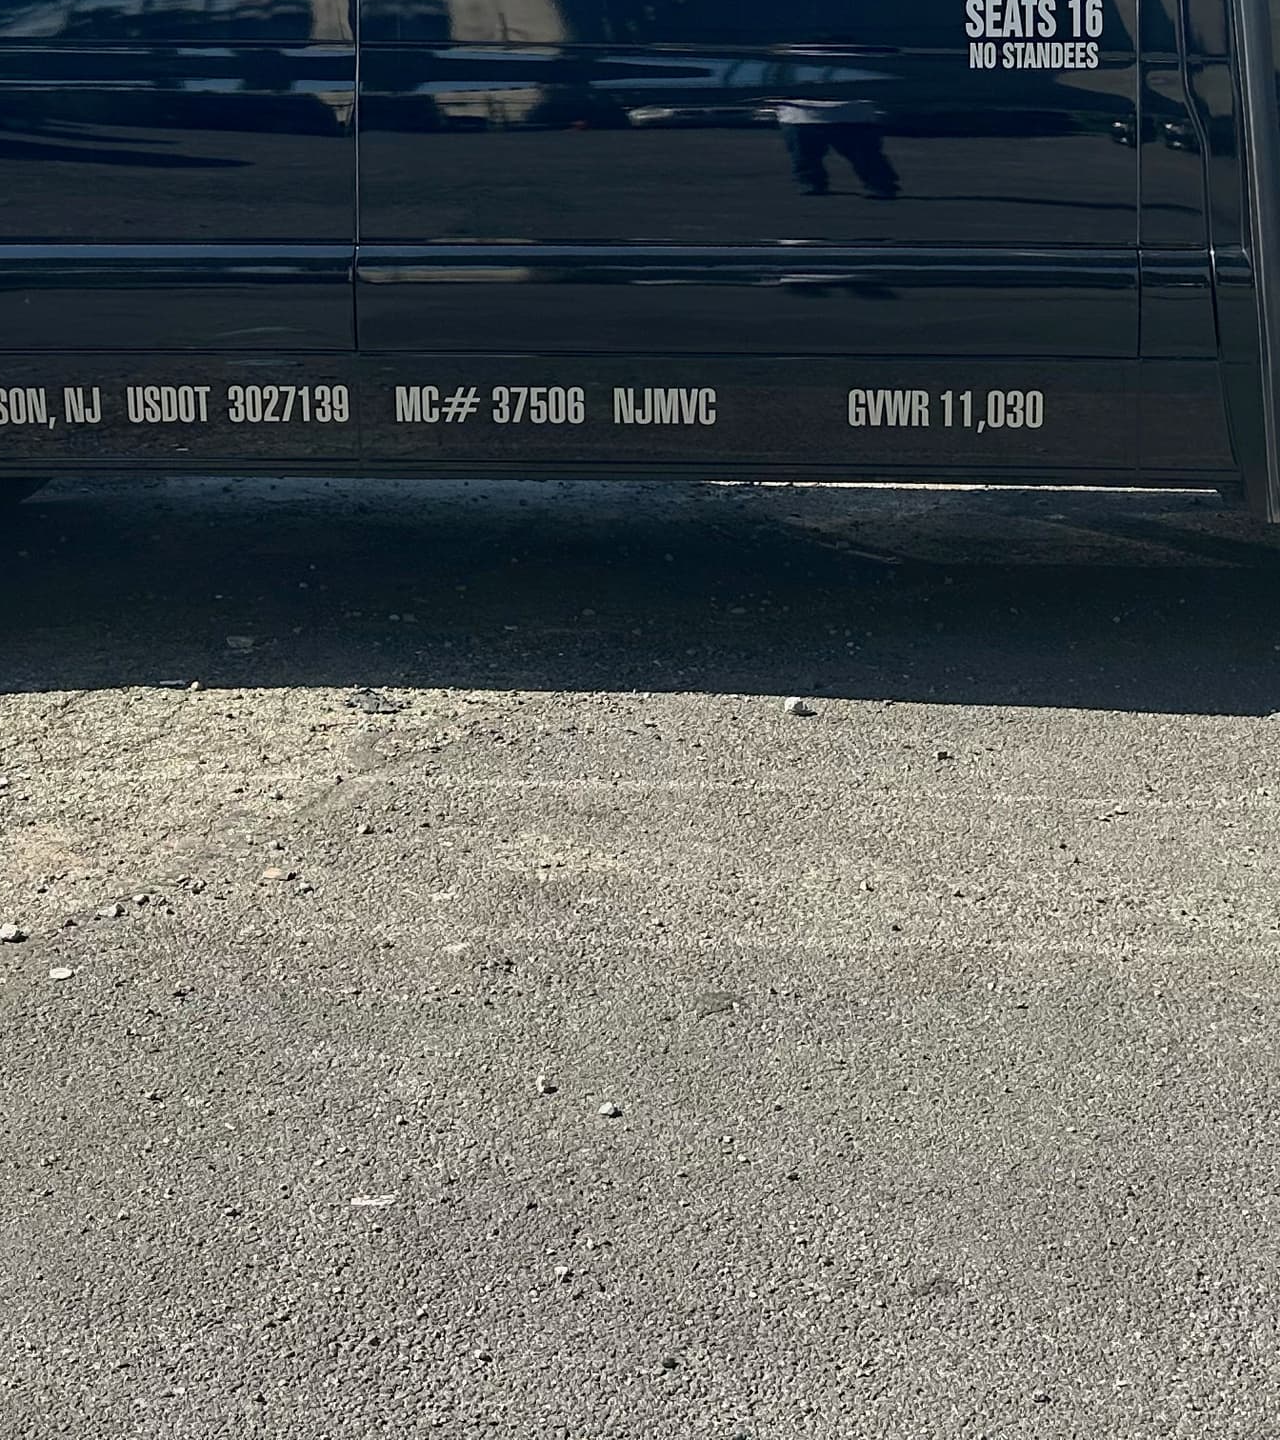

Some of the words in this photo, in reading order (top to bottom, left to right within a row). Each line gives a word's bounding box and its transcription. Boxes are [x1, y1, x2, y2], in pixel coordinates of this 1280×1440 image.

[969, 42, 997, 69] NO
[1002, 42, 1099, 69] STANDEES
[63, 387, 102, 424] NJ
[126, 385, 211, 423] USDOT
[228, 385, 349, 423] 3027139
[395, 385, 481, 423] MC#
[492, 386, 585, 424] 37506
[613, 387, 717, 425] NJMVC
[847, 388, 930, 427] GVWR
[940, 390, 1044, 434] 11,030
